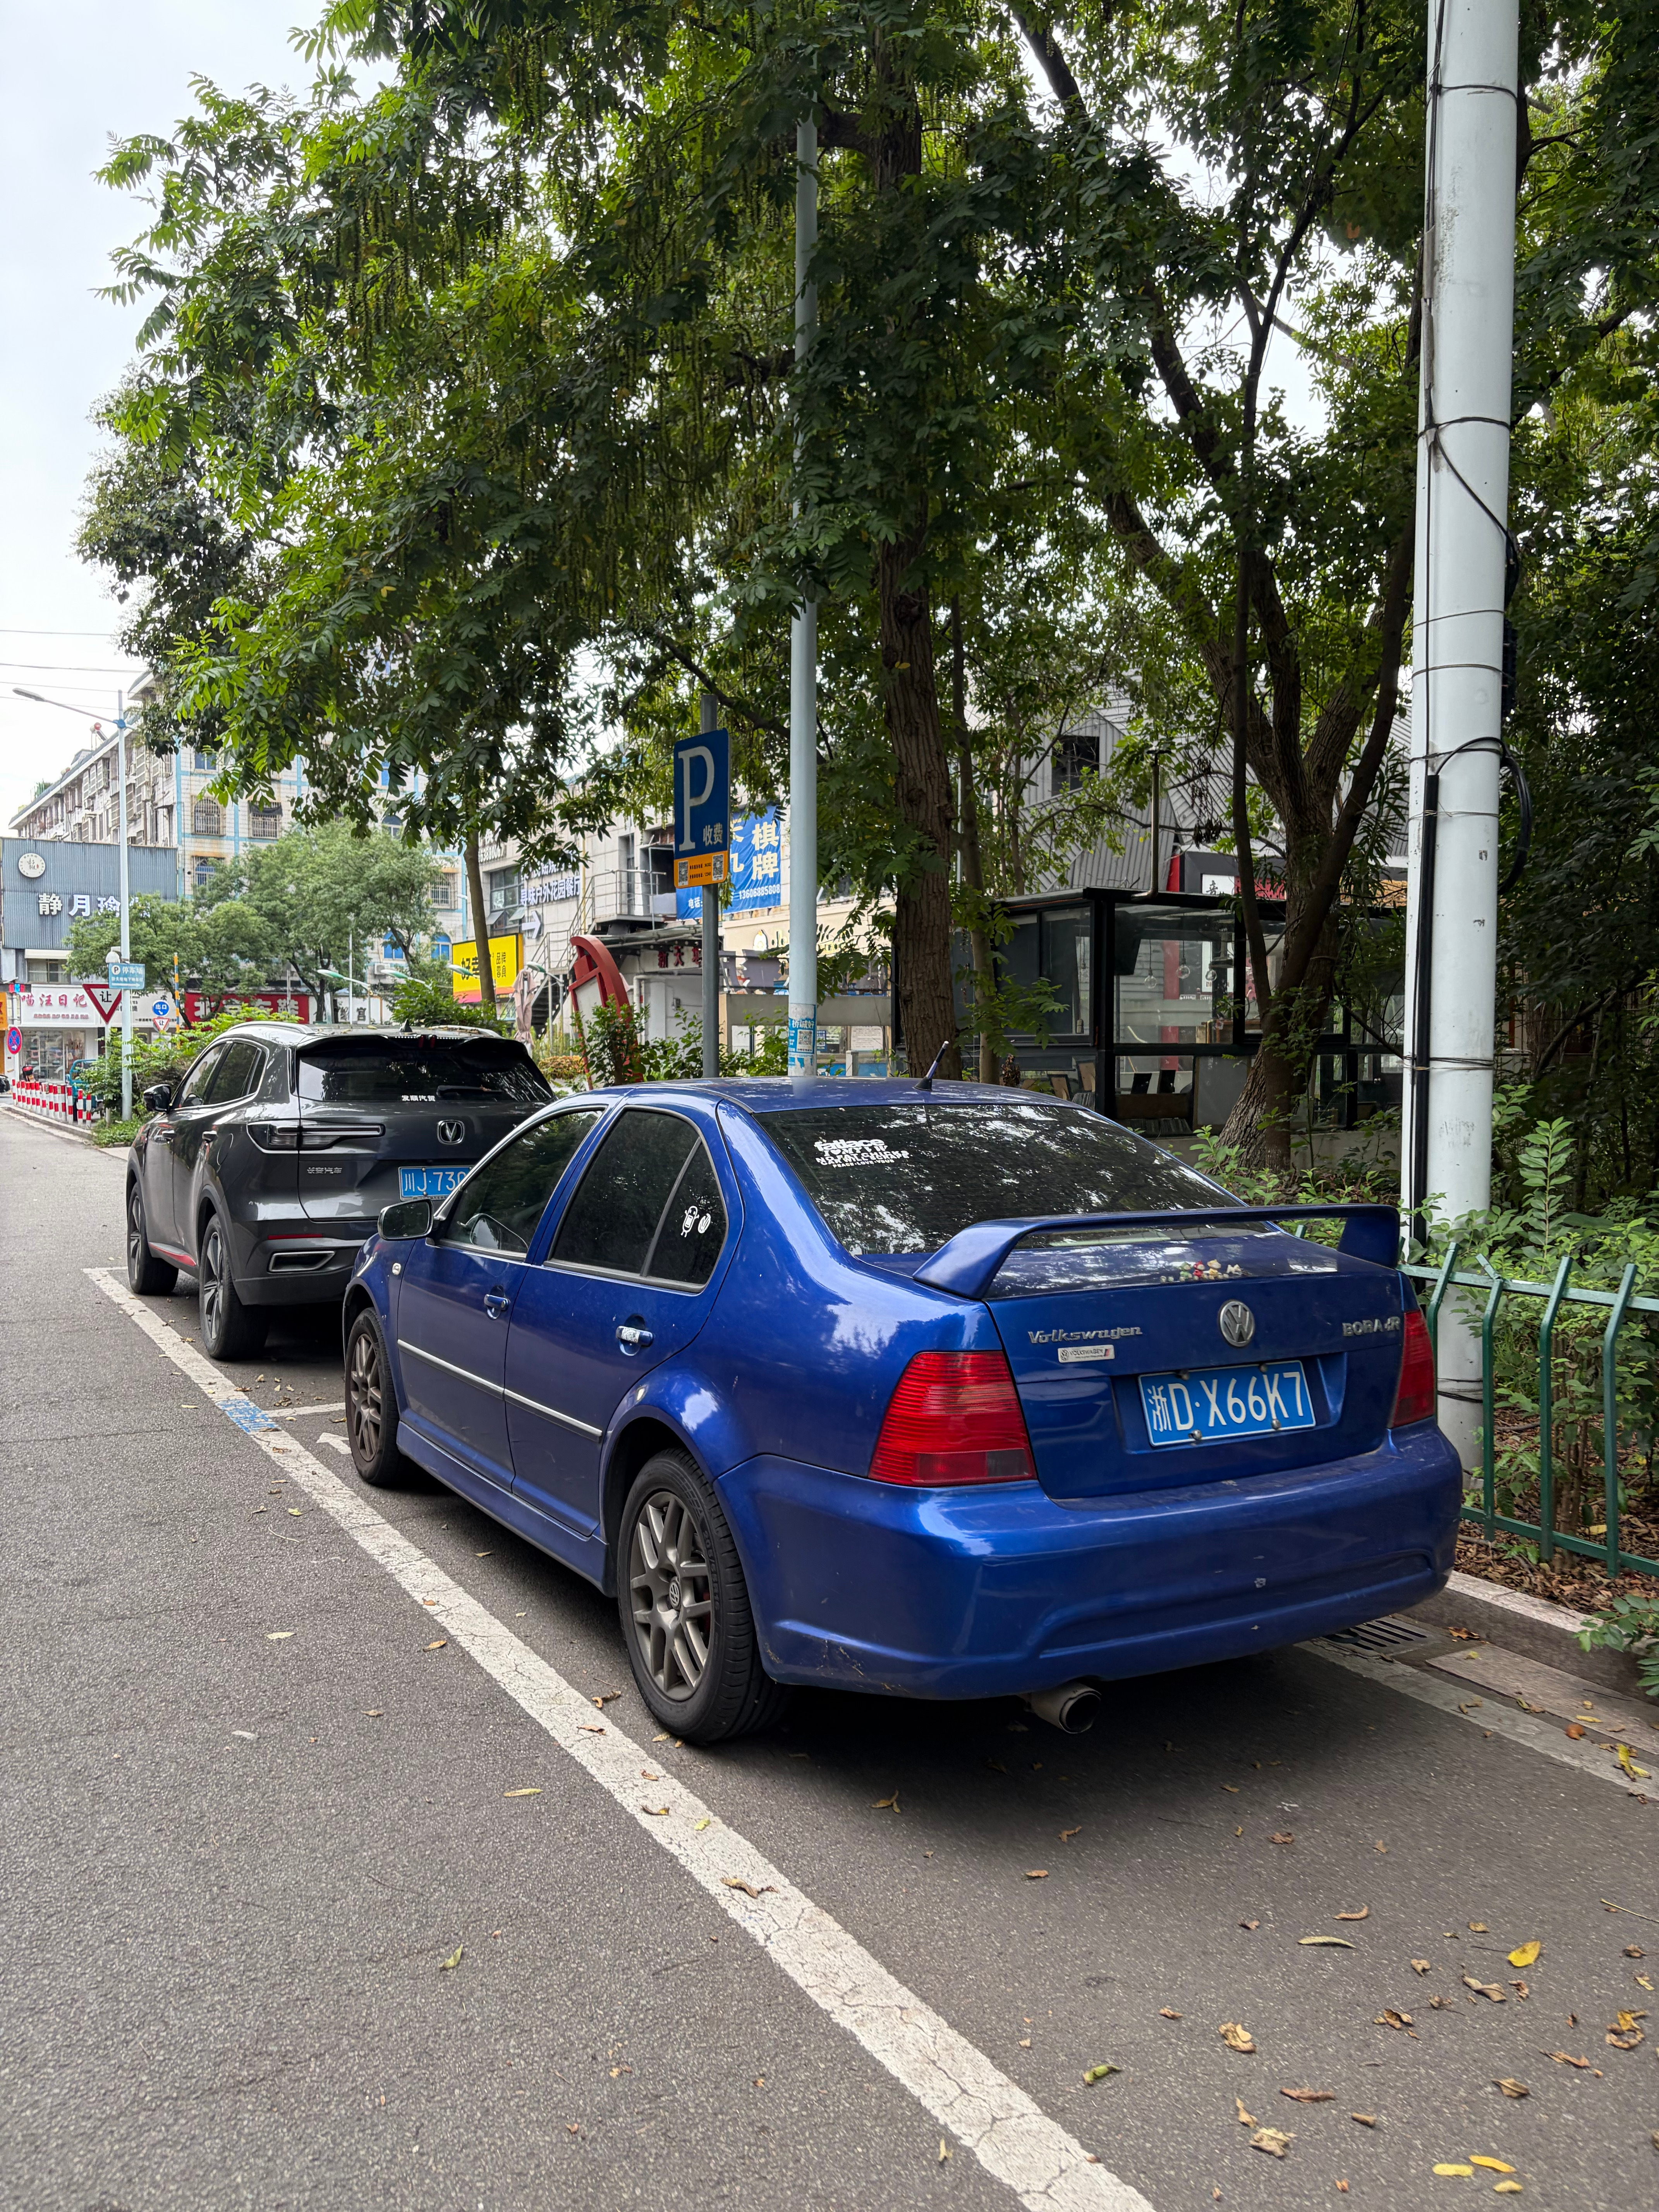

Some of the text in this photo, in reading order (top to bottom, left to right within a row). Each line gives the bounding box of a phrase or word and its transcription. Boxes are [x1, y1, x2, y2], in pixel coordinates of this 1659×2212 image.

[678, 746, 714, 851] P
[703, 822, 723, 846] 收费
[520, 875, 580, 907] 寻味户外花园餐厅
[21, 993, 88, 1008] 喵汪日记
[100, 991, 112, 1002] 让
[1028, 1327, 1143, 1343] Volkswagen
[1147, 1371, 1304, 1432] 浙D·X66K7
